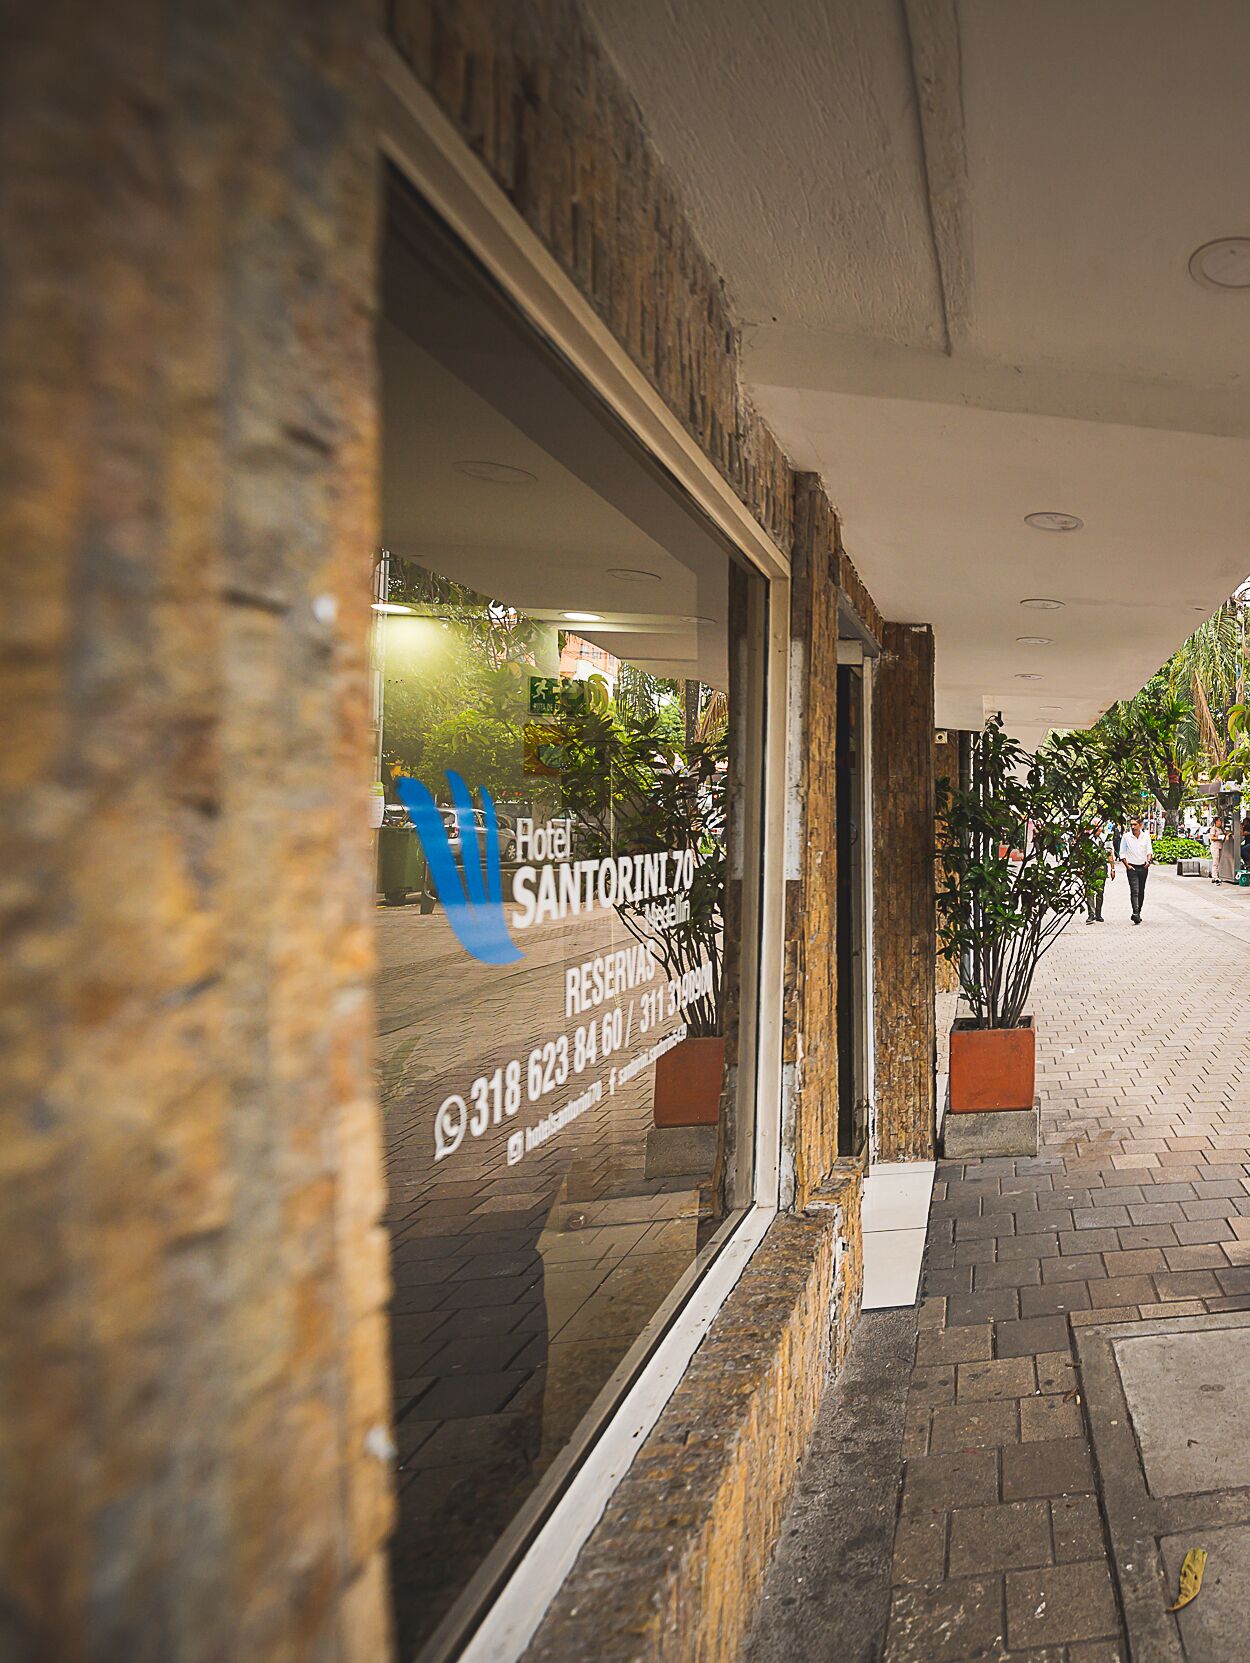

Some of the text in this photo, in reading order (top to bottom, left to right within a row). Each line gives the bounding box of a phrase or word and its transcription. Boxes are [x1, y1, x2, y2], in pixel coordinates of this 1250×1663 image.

[515, 818, 572, 862] Hotel
[512, 849, 694, 929] SANTORINI 70
[565, 939, 656, 1018] RESERVAS
[470, 1060, 521, 1137] 318
[527, 1035, 569, 1101] 623
[573, 1020, 597, 1073] 84
[601, 1007, 623, 1056] 60
[625, 1000, 635, 1047] /
[640, 986, 664, 1033] 311
